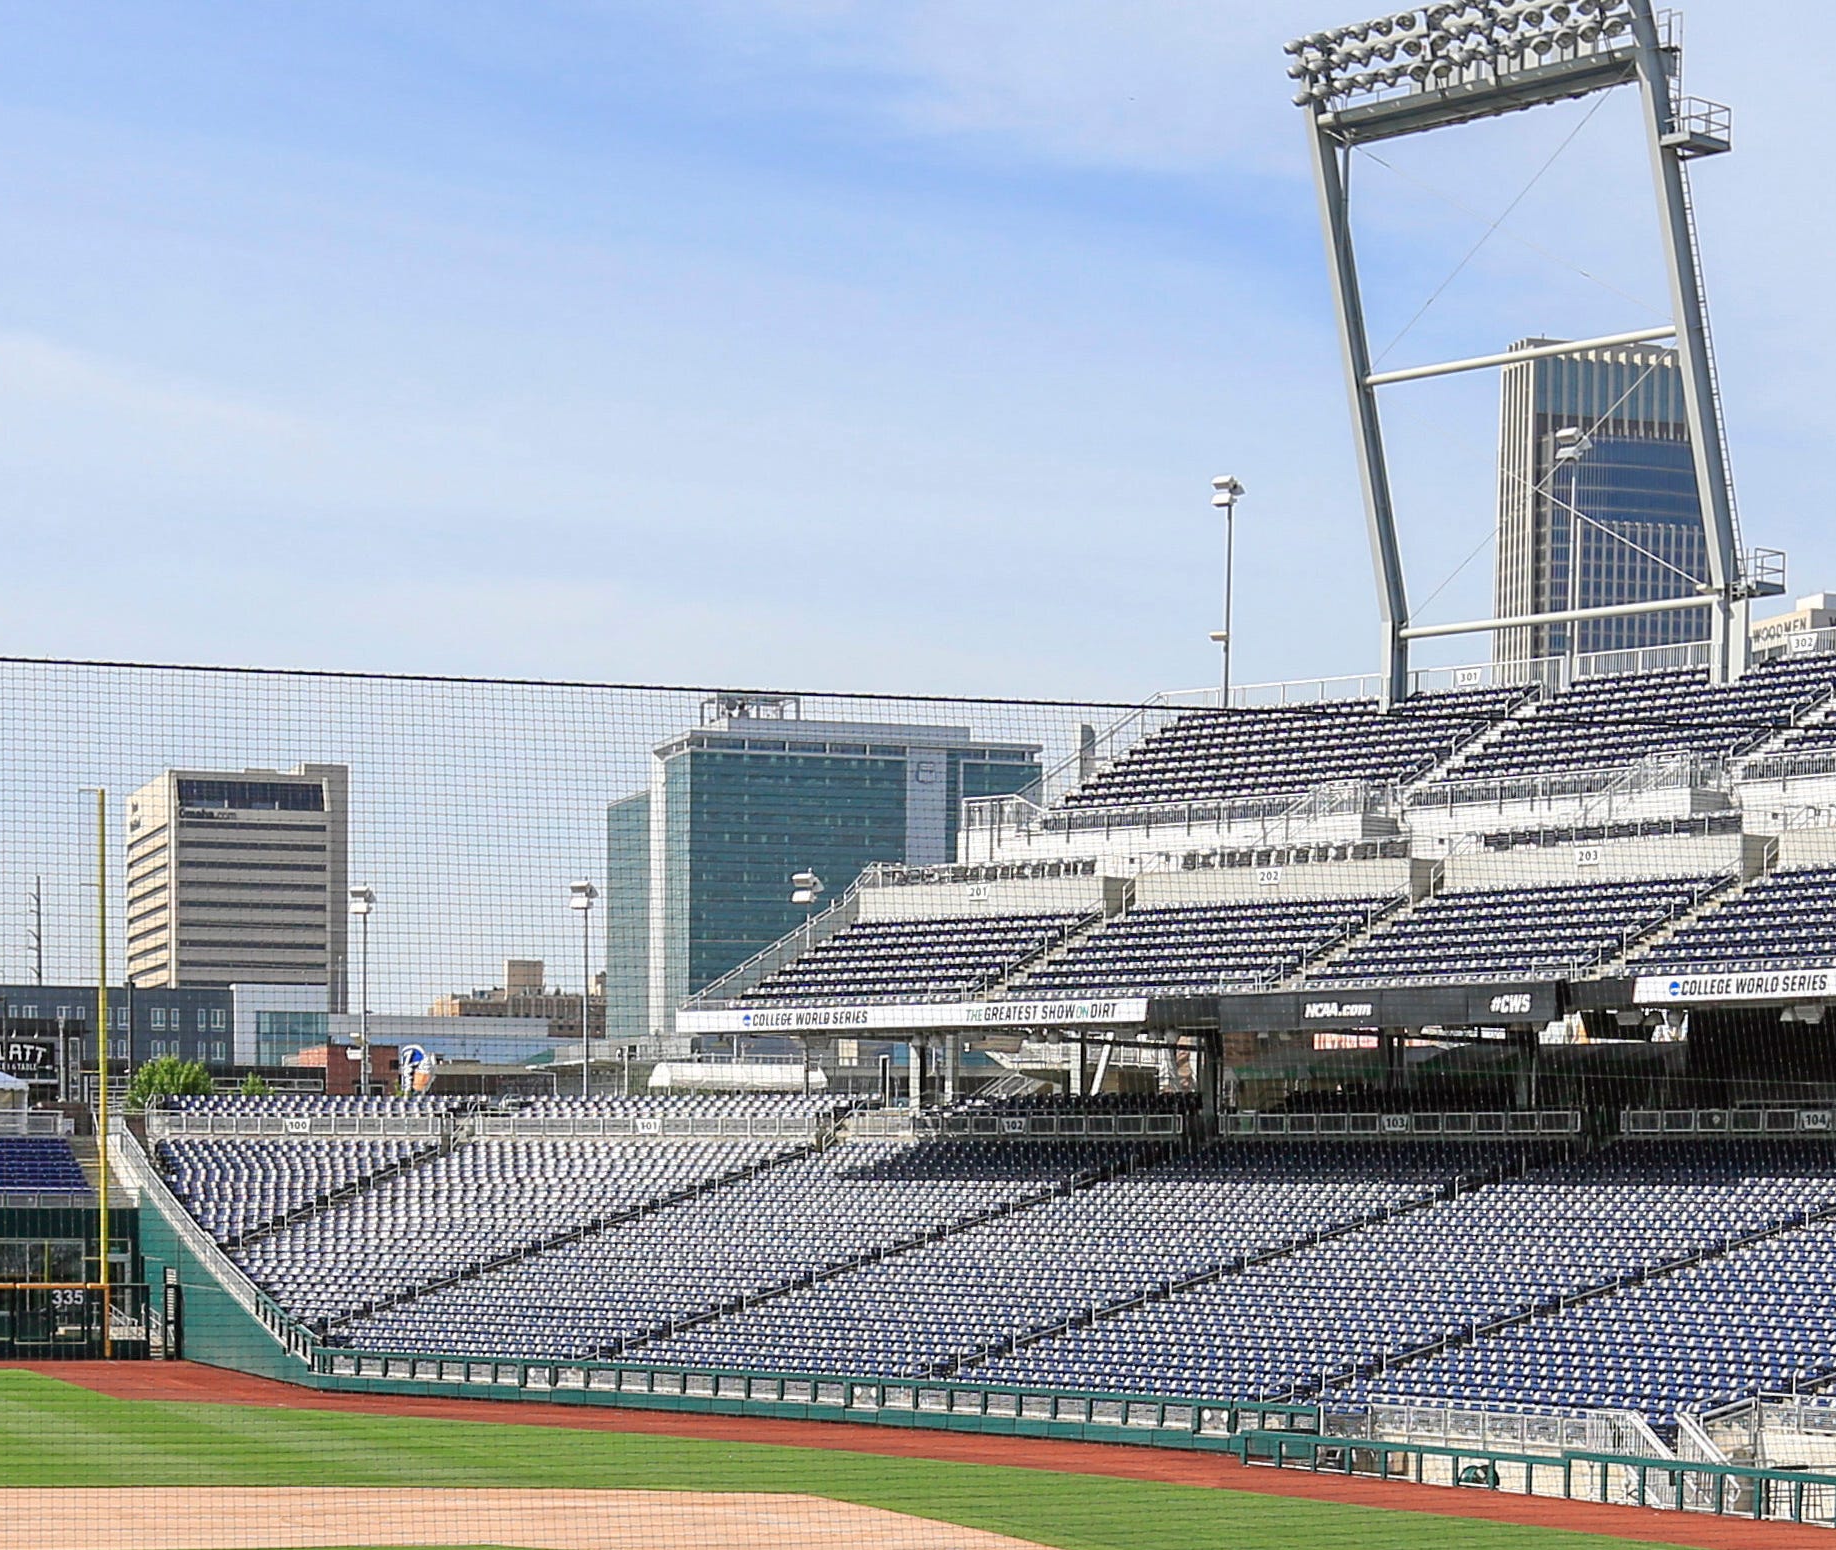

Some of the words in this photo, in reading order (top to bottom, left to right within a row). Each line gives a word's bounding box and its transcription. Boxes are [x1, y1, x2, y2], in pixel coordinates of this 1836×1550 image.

[1752, 617, 1807, 639] WOODMEN
[1794, 638, 1813, 648] 302
[1460, 672, 1478, 683] 301
[1577, 850, 1598, 861] 203
[1260, 871, 1280, 882] 202
[969, 887, 988, 898] 201
[1681, 979, 1731, 996] COLLEGE
[1736, 976, 1779, 994] WORLD
[1782, 974, 1828, 991] SERIES
[1489, 994, 1531, 1013] #CWS
[966, 1009, 983, 1022] THE
[984, 1005, 1039, 1021] GREATEST
[1041, 1004, 1075, 1019] SHOW
[1075, 1005, 1089, 1018] ON
[1090, 1003, 1118, 1018] DIRT
[1304, 1002, 1372, 1018] NCAA.com
[752, 1013, 792, 1026] COLLEGE
[796, 1011, 830, 1025] WORLD
[832, 1010, 868, 1025] SERIES
[289, 1120, 308, 1131] 100
[640, 1120, 657, 1131] 101
[1005, 1120, 1023, 1131] 102
[1385, 1116, 1406, 1128] 103
[1805, 1113, 1826, 1126] 104
[51, 1289, 84, 1305] 335
